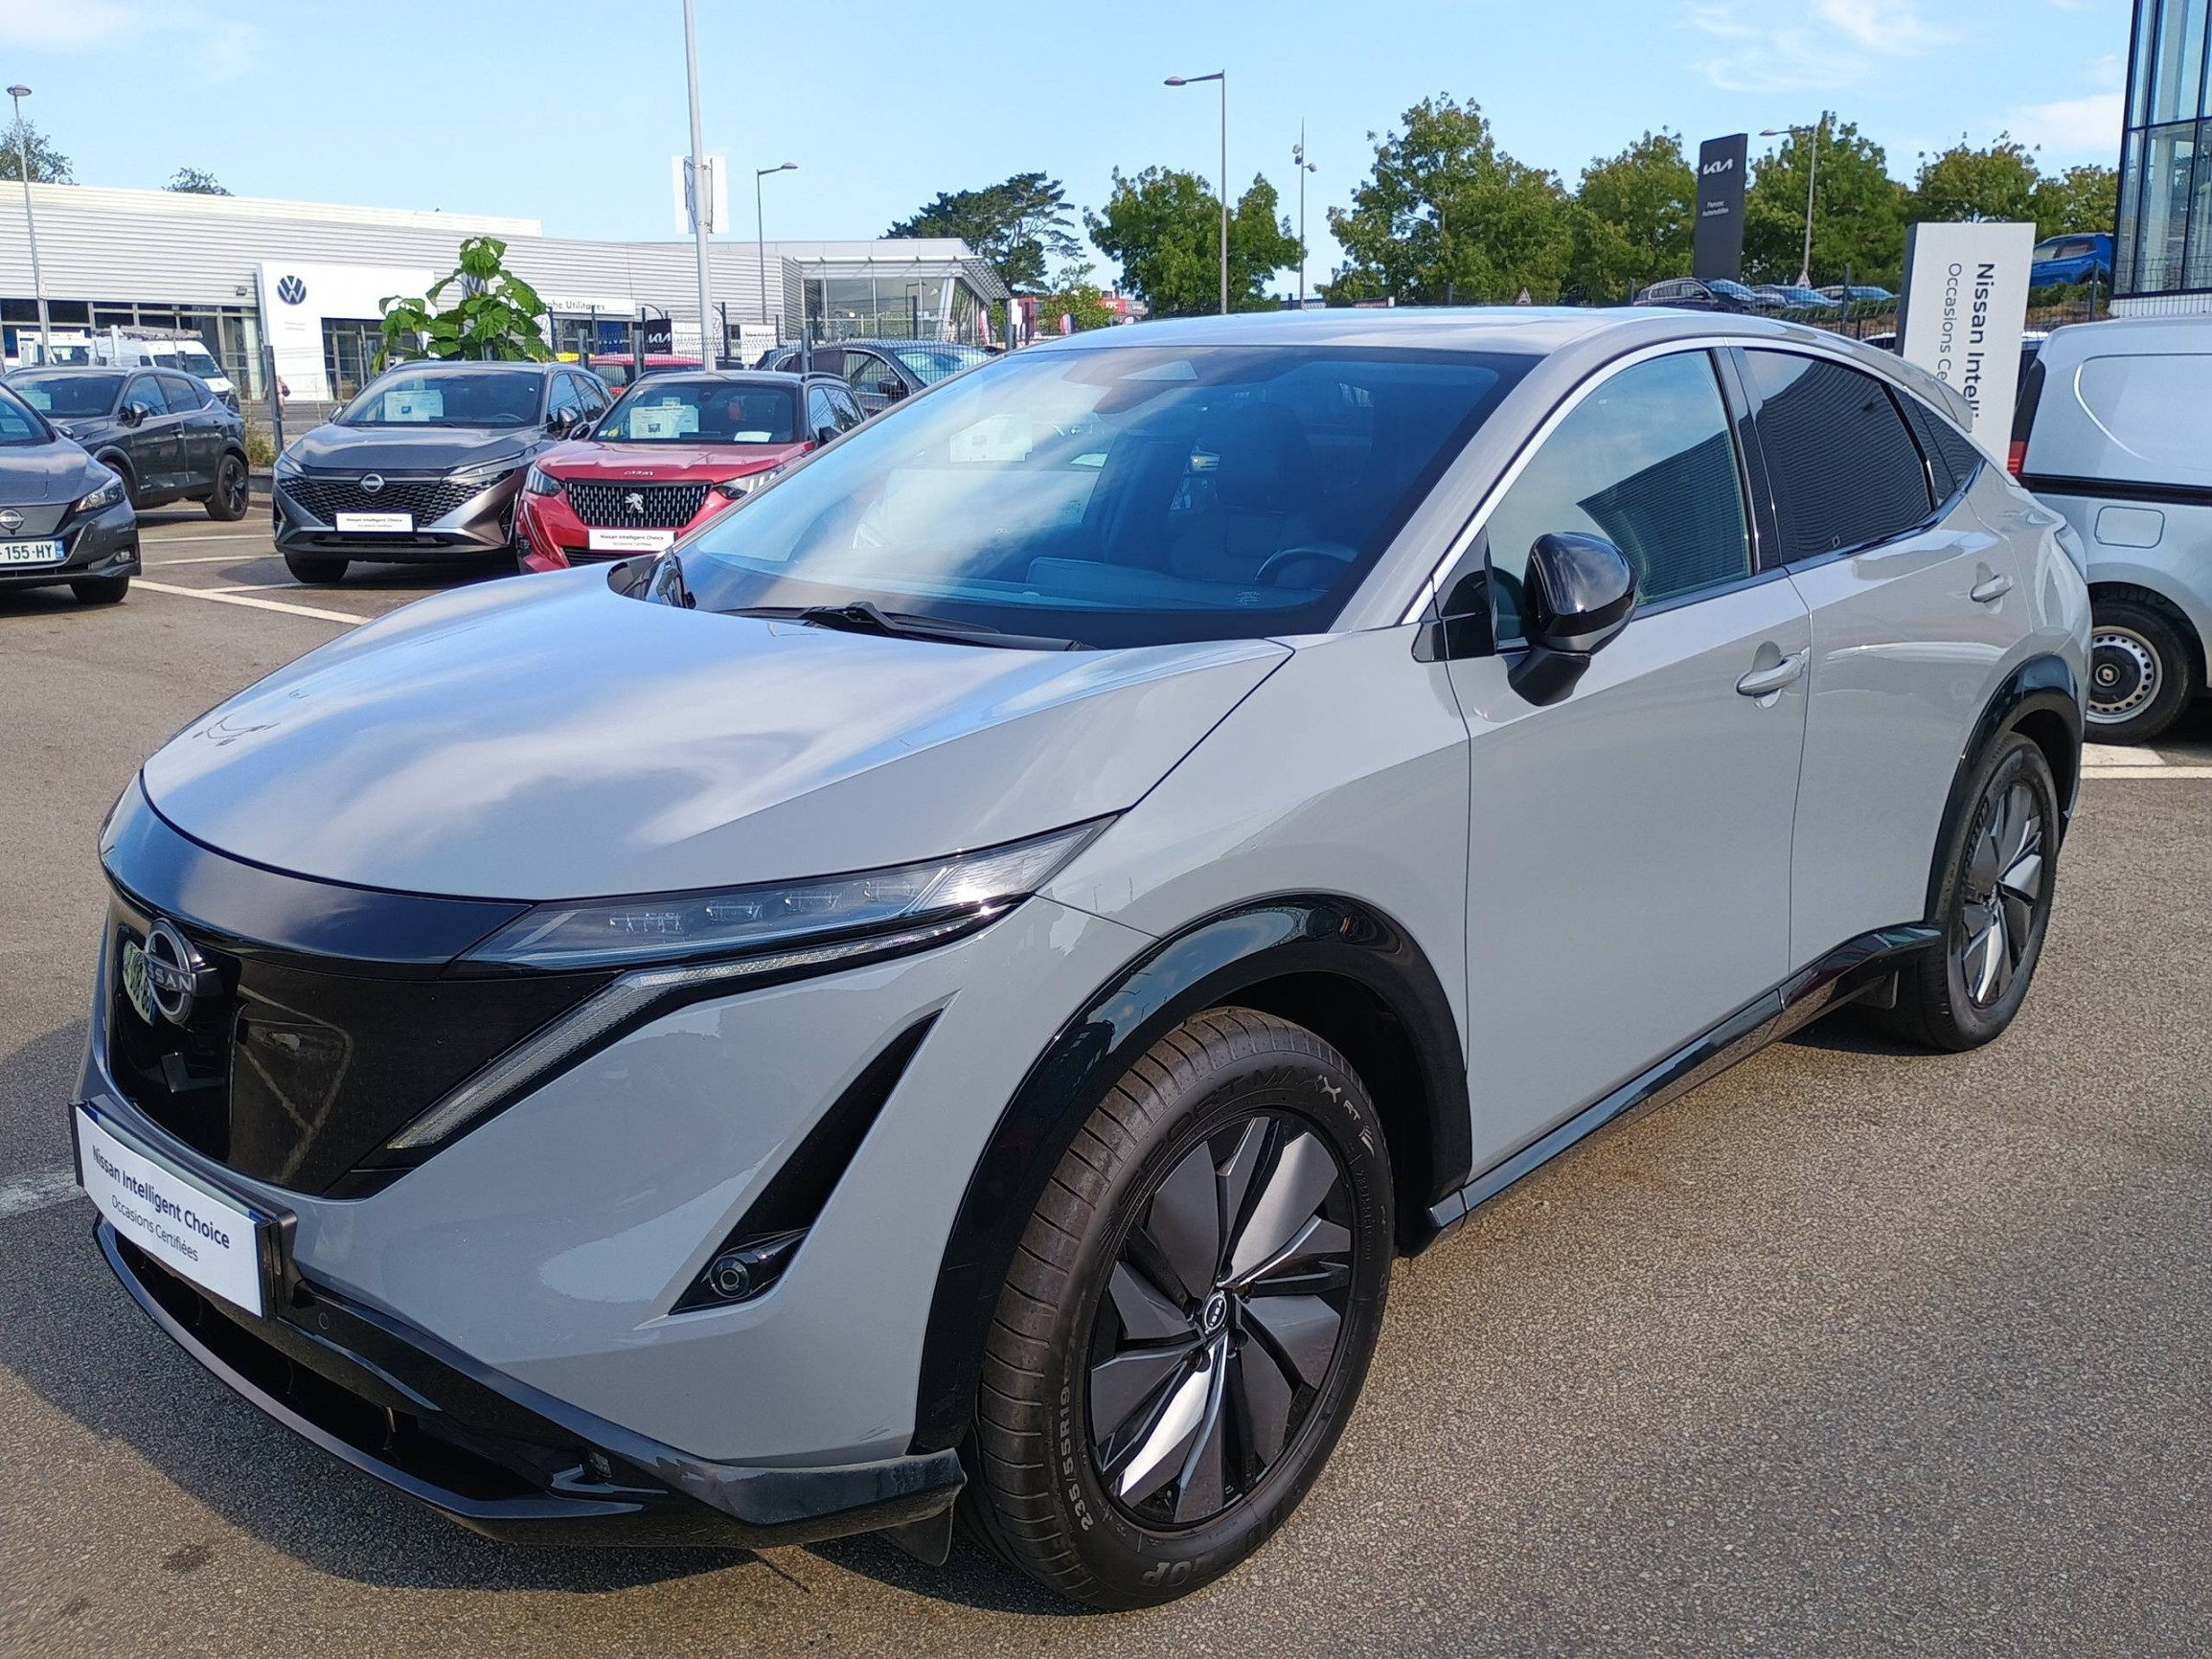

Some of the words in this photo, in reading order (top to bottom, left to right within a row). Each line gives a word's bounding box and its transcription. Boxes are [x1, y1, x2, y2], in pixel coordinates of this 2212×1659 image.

[1939, 262, 1963, 353] Occasions
[1970, 263, 1995, 344] Nissan
[92, 1144, 121, 1184] Nissan
[122, 1170, 182, 1223] Intelligent
[184, 1209, 230, 1250] Choice
[111, 1193, 154, 1234] Occasions
[155, 1223, 199, 1262] Certifiées
